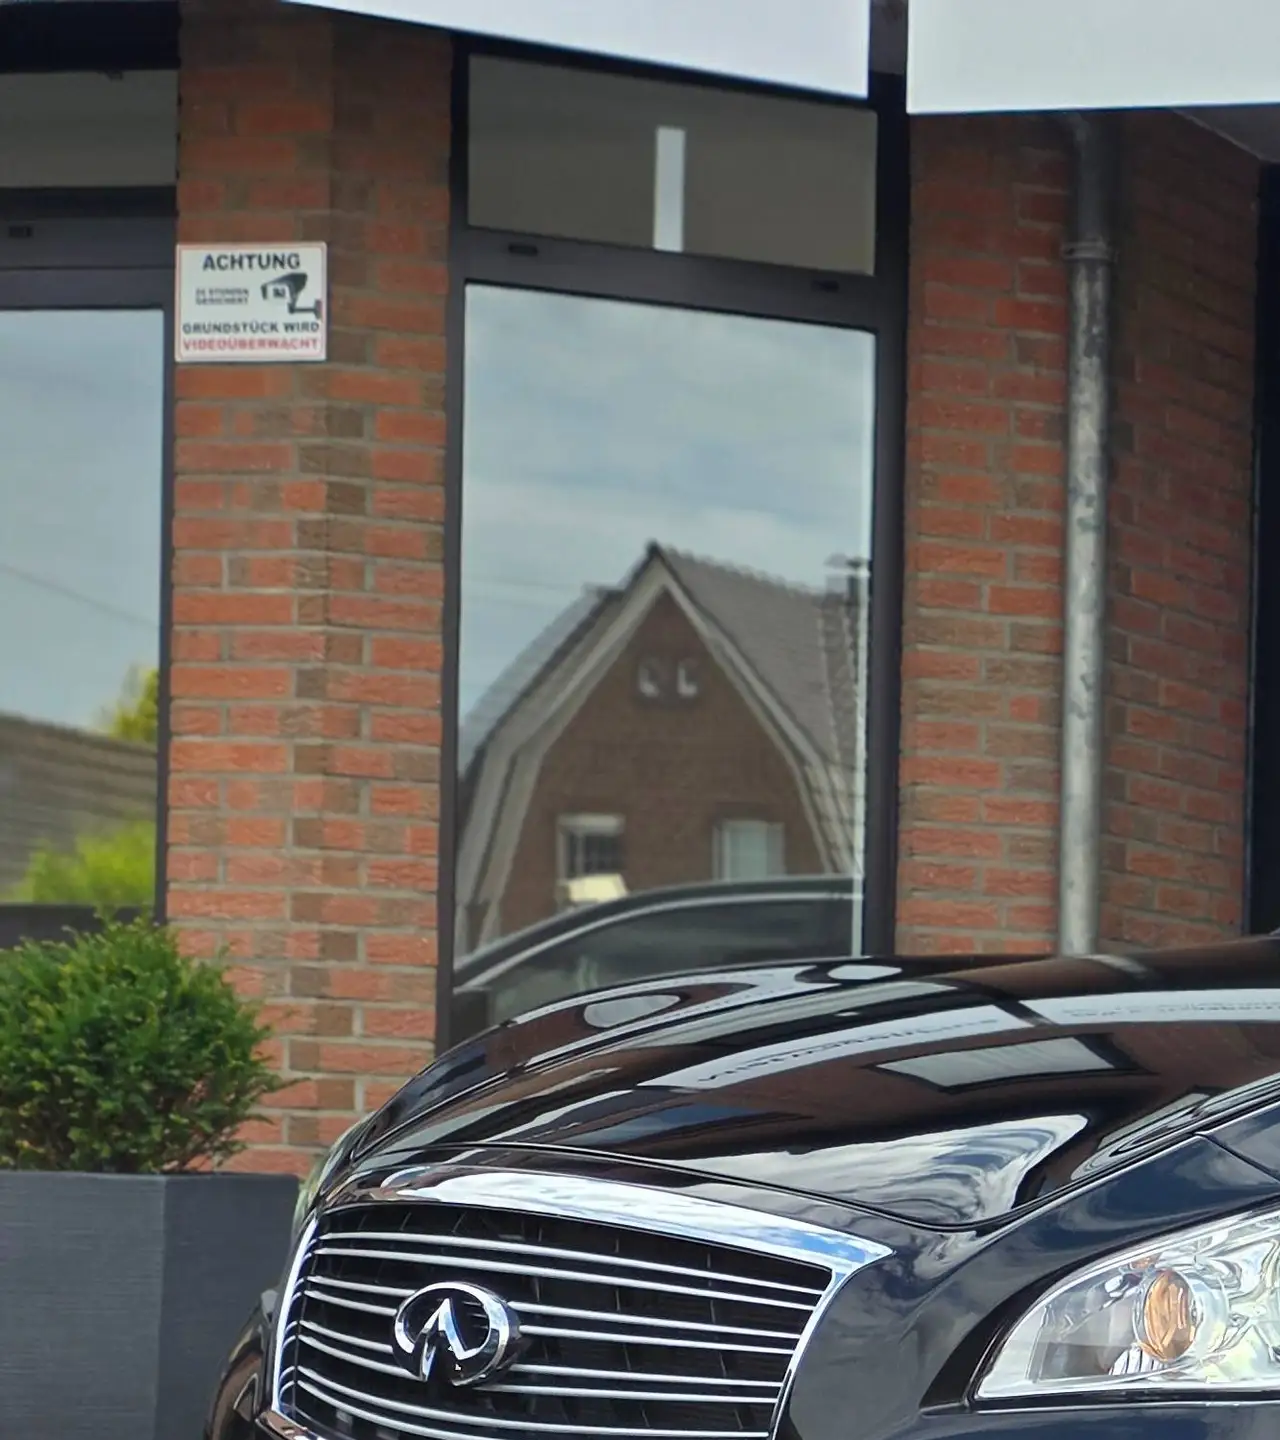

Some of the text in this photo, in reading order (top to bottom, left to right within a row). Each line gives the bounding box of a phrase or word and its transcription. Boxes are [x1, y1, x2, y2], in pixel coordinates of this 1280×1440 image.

[203, 253, 301, 271] ACHTUNG
[182, 319, 320, 334] GRUNDSTÜCK WIRD
[183, 335, 318, 351] VIDEOÜBERWACHT
